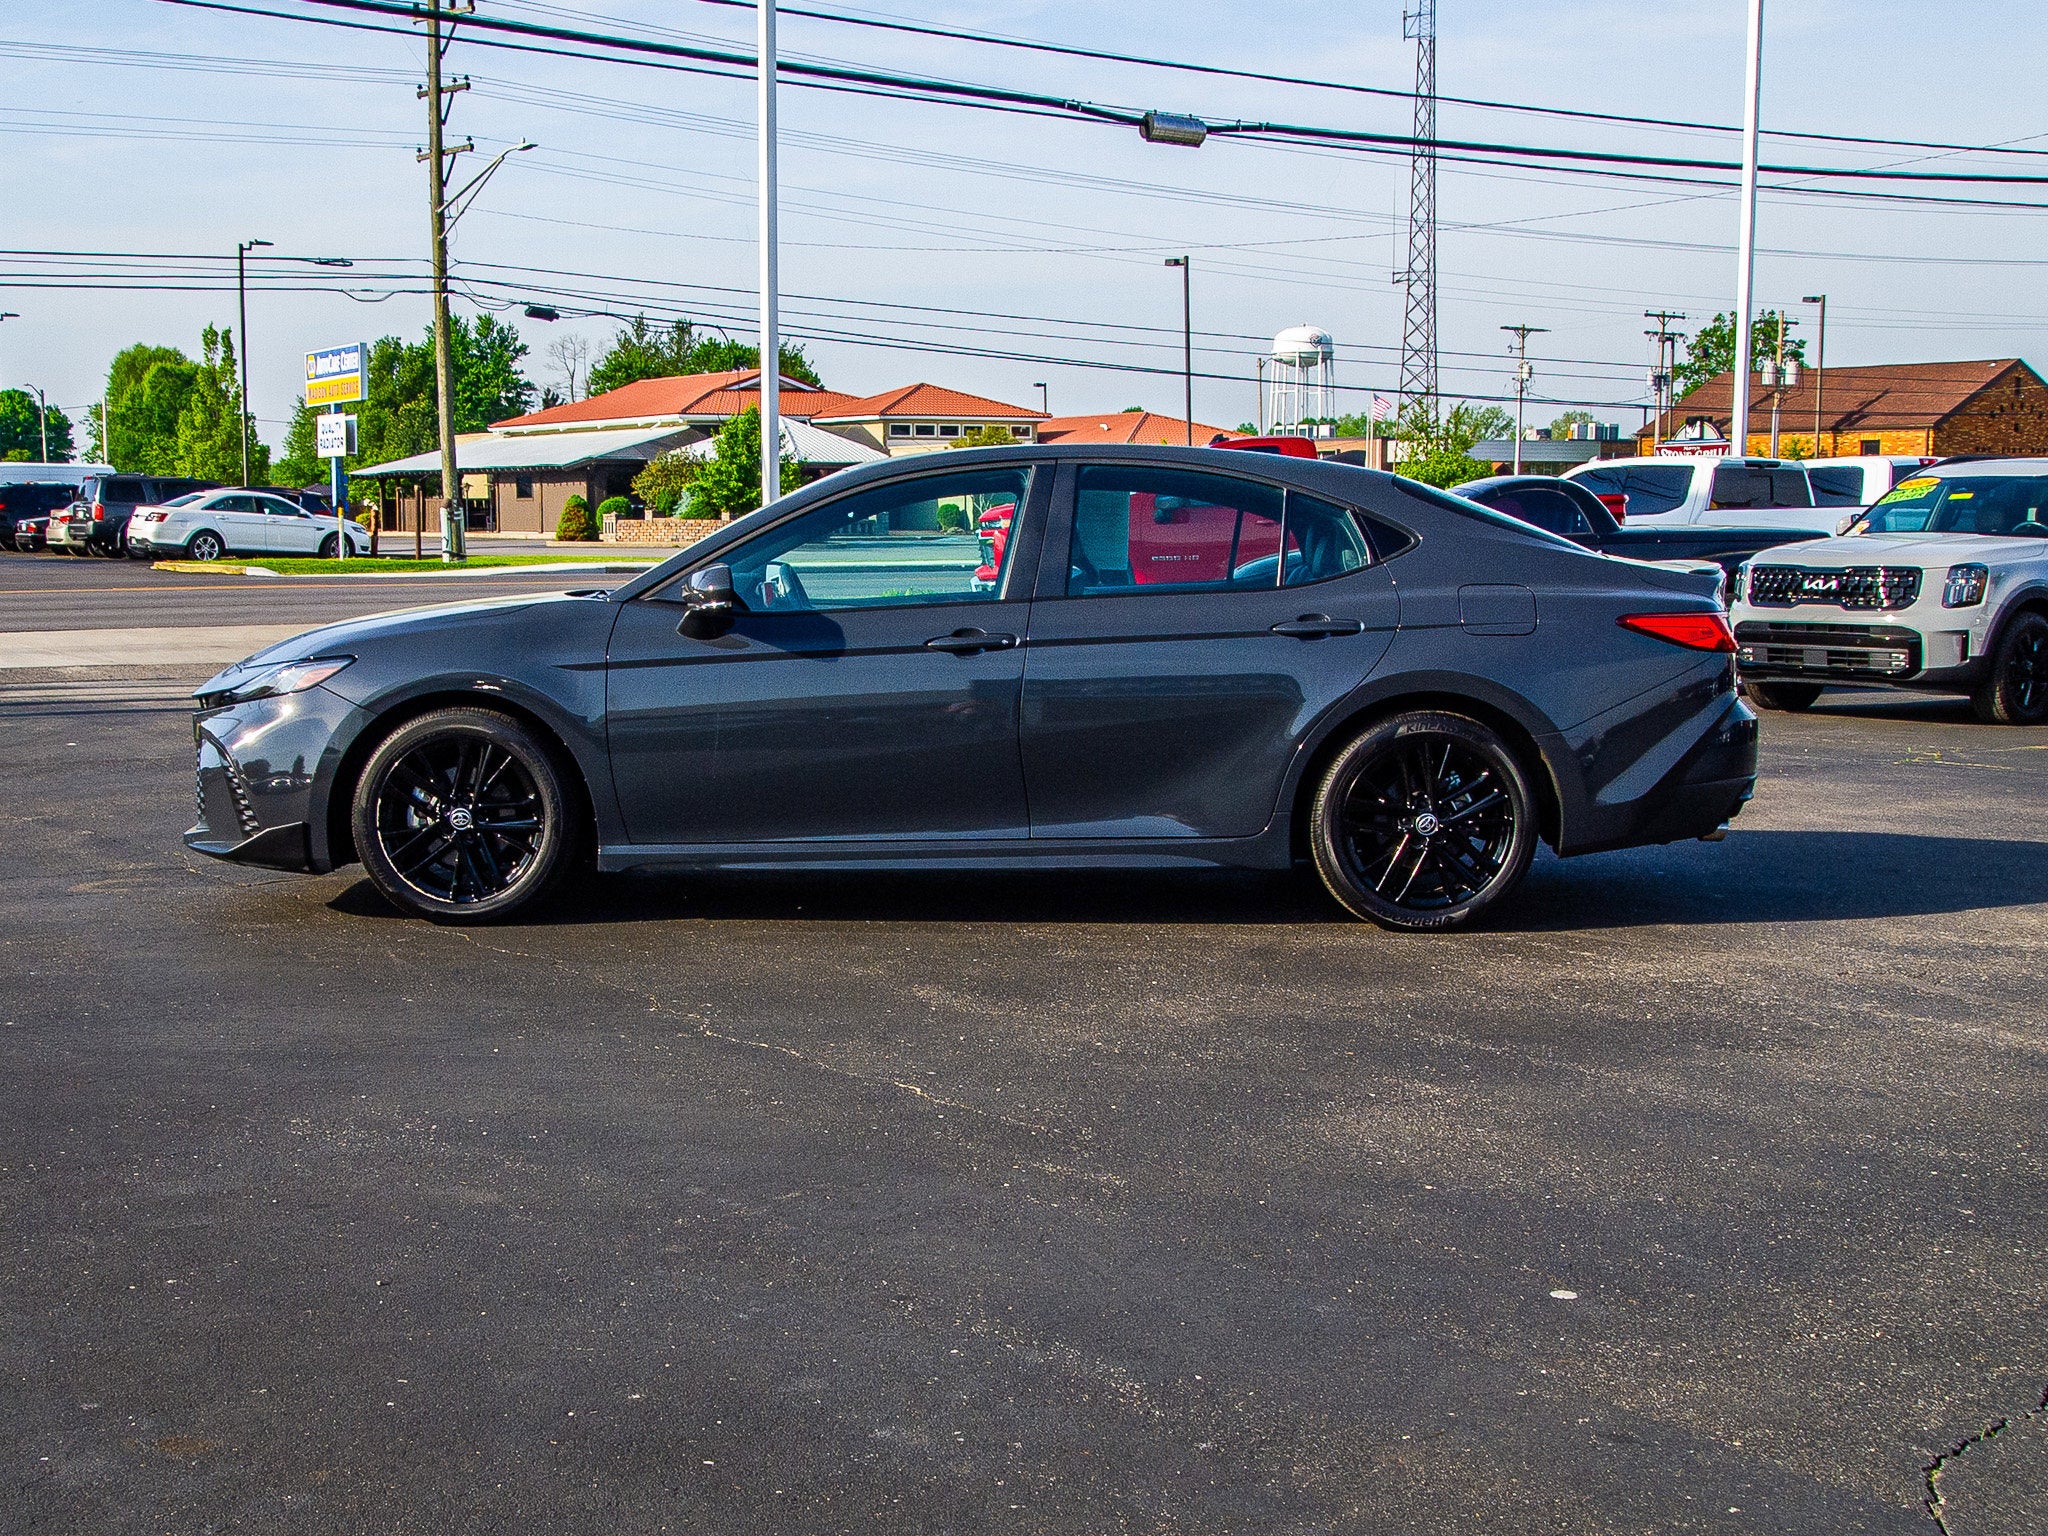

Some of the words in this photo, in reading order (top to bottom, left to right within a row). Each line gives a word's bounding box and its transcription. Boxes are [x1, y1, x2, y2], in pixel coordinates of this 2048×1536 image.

[329, 384, 339, 397] AUTO
[341, 381, 359, 395] SERVICE
[319, 436, 344, 449] RADIATOR
[1802, 578, 1839, 591] KIA
